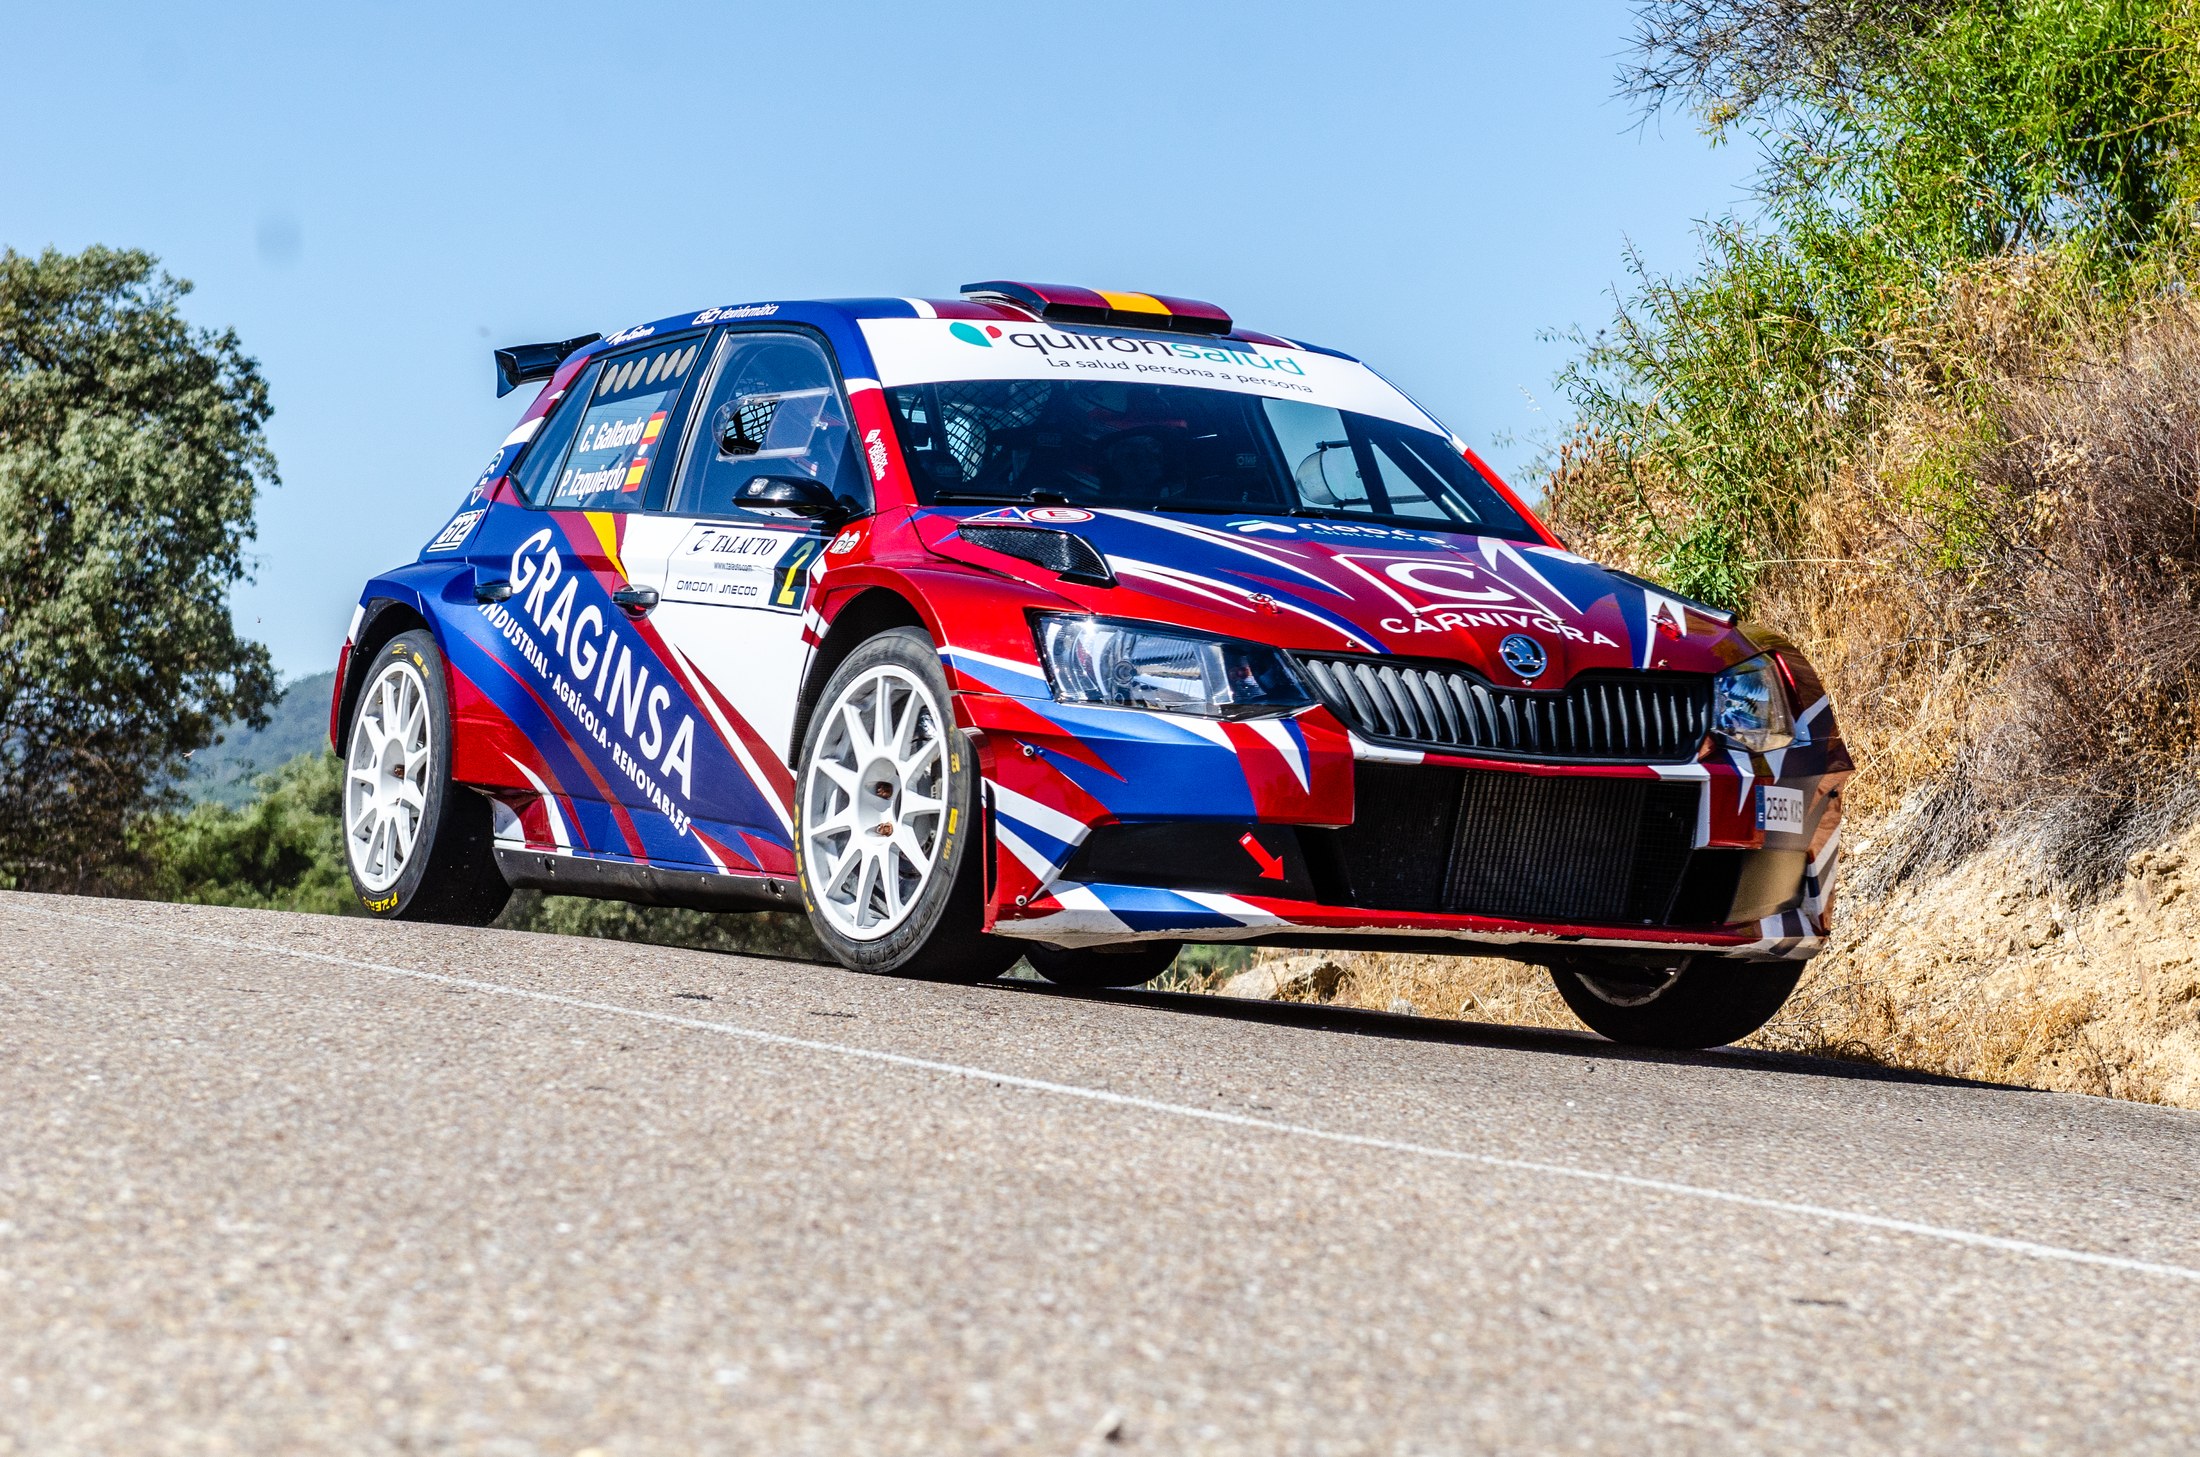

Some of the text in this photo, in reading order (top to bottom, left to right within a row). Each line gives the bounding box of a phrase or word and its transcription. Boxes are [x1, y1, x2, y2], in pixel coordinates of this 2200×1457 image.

[1047, 358, 1313, 394] La salud persona a persona
[579, 417, 645, 453] C. Gallardo
[556, 462, 627, 501] P. Izquierdo
[710, 534, 778, 556] TALAUTO
[676, 579, 713, 593] OMODA
[719, 584, 758, 597] JAECOO
[777, 540, 816, 605] 2
[1384, 562, 1517, 602] C
[1379, 608, 1620, 649] CARNIVORA
[510, 527, 696, 800] GRAGINSA
[552, 673, 609, 748] AGRÍCOLA
[612, 741, 692, 837] RENOVABLES
[1766, 796, 1788, 821] 2585
